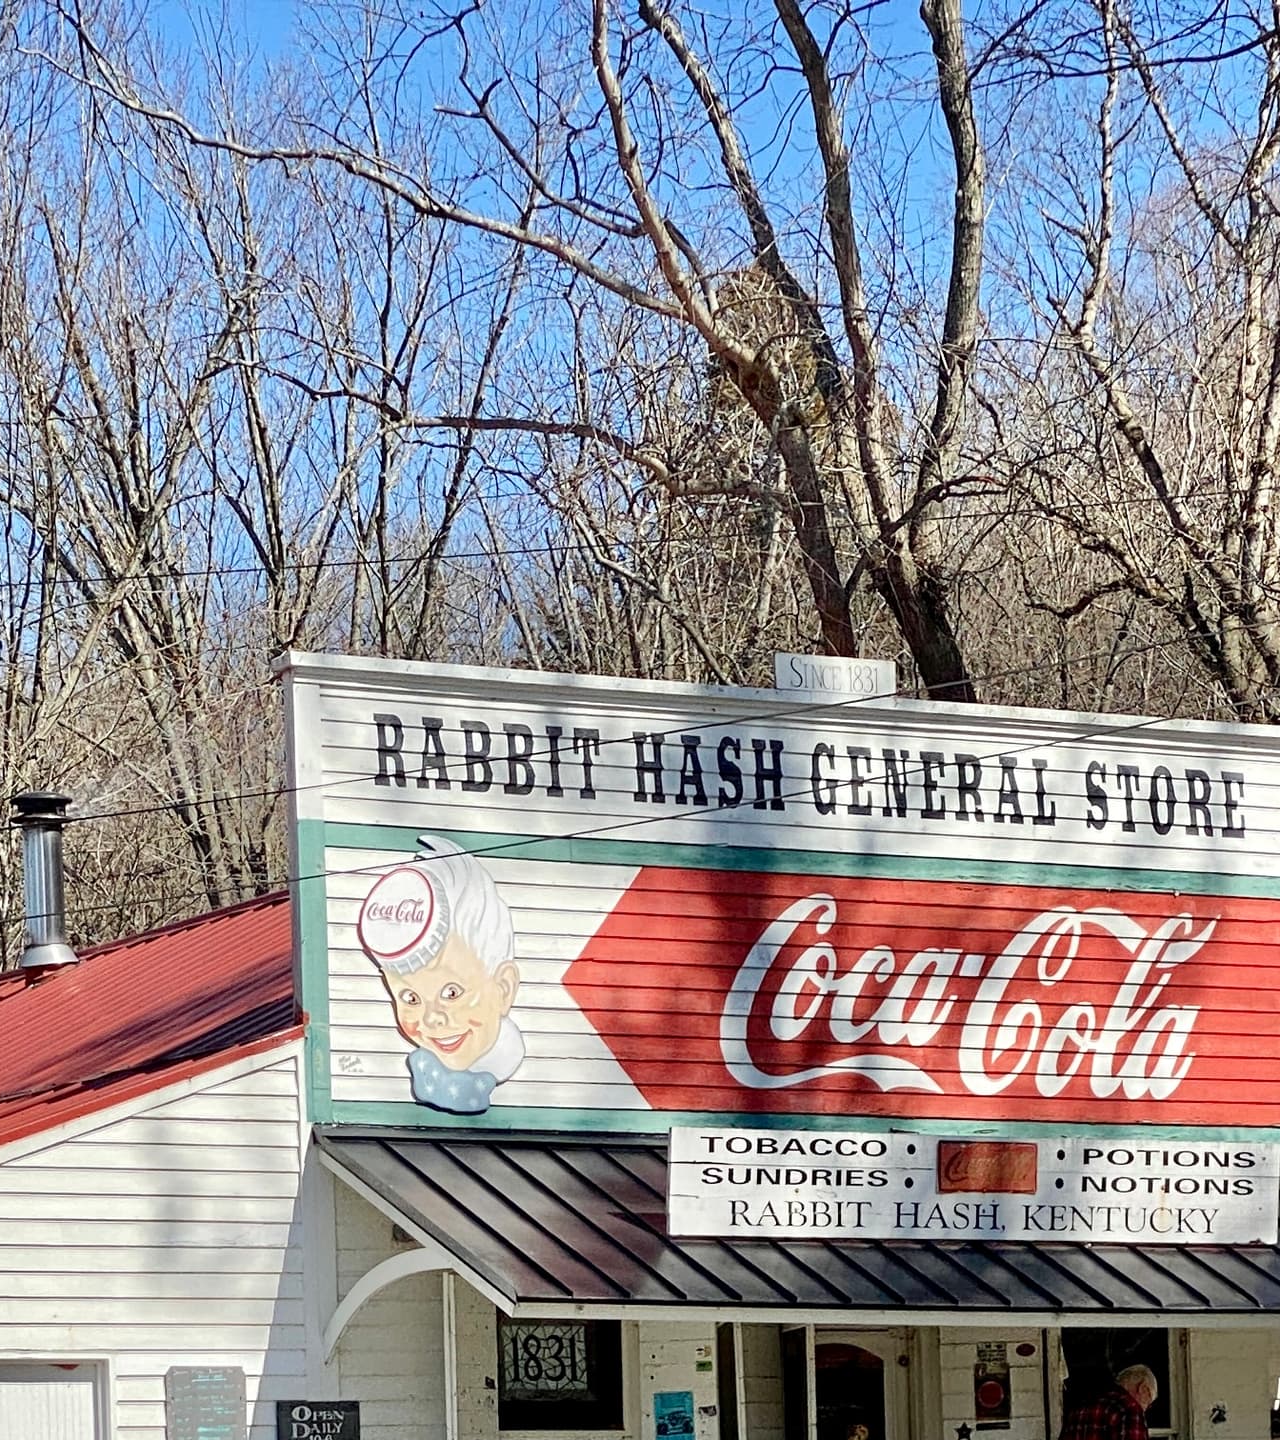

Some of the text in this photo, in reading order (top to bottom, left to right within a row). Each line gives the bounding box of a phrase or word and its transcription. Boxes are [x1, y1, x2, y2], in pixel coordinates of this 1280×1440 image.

[790, 656, 879, 694] SINCE 1831
[372, 713, 1246, 838] RABBIT HASH GENERAL STORE
[367, 898, 424, 923] Coca-Cola
[720, 893, 1221, 1100] Coca-Cola
[700, 1136, 888, 1157] TOBACCO
[1082, 1149, 1256, 1168] POTIONS
[701, 1167, 889, 1187] SUNDRIES
[1081, 1176, 1254, 1196] NOTIONS
[728, 1200, 1220, 1233] RABBIT HASH, KENTUCKY
[511, 1333, 578, 1382] 1831
[291, 1405, 345, 1421] OPEN
[291, 1422, 343, 1438] DAILY
